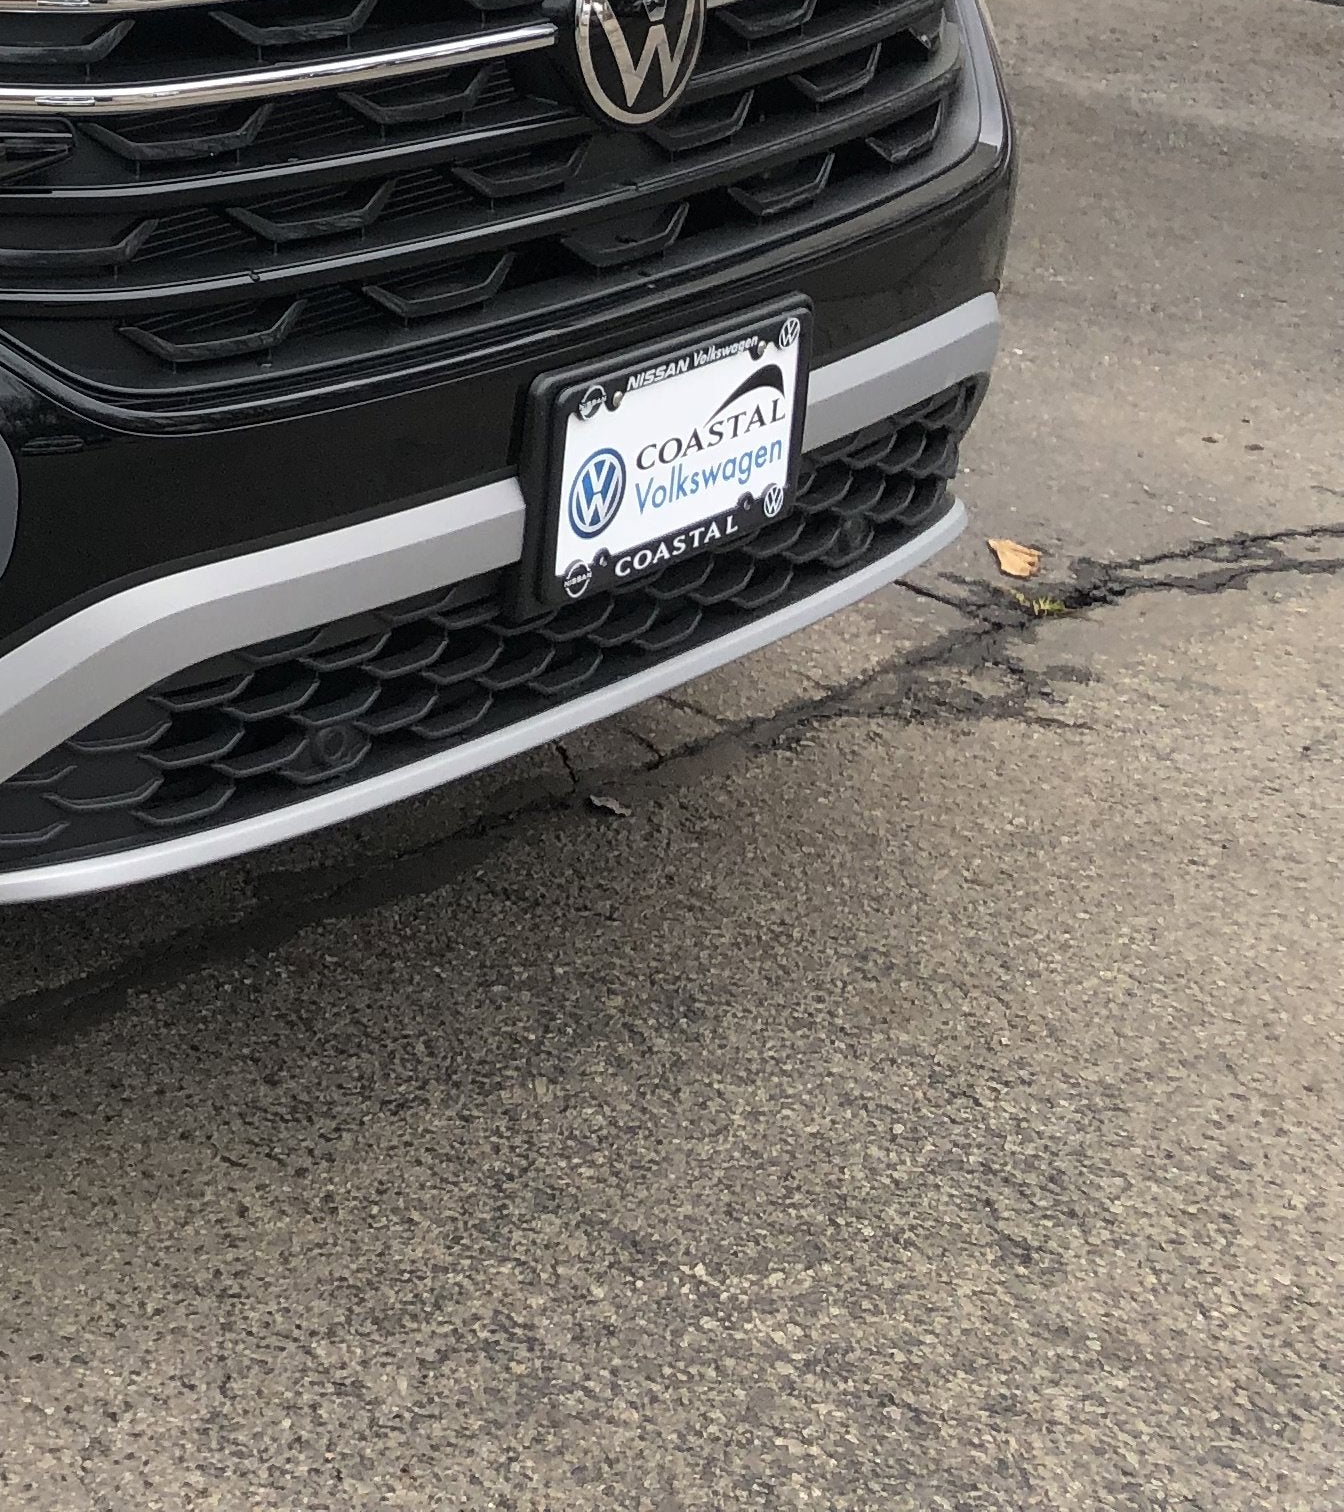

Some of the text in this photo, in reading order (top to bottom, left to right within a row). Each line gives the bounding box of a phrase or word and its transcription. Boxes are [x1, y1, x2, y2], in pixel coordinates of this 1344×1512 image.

[627, 335, 759, 391] NISSAN Volkswagen
[636, 398, 786, 470] COASTAL
[635, 439, 782, 515] Volkswagen
[615, 515, 739, 577] COASTAL
